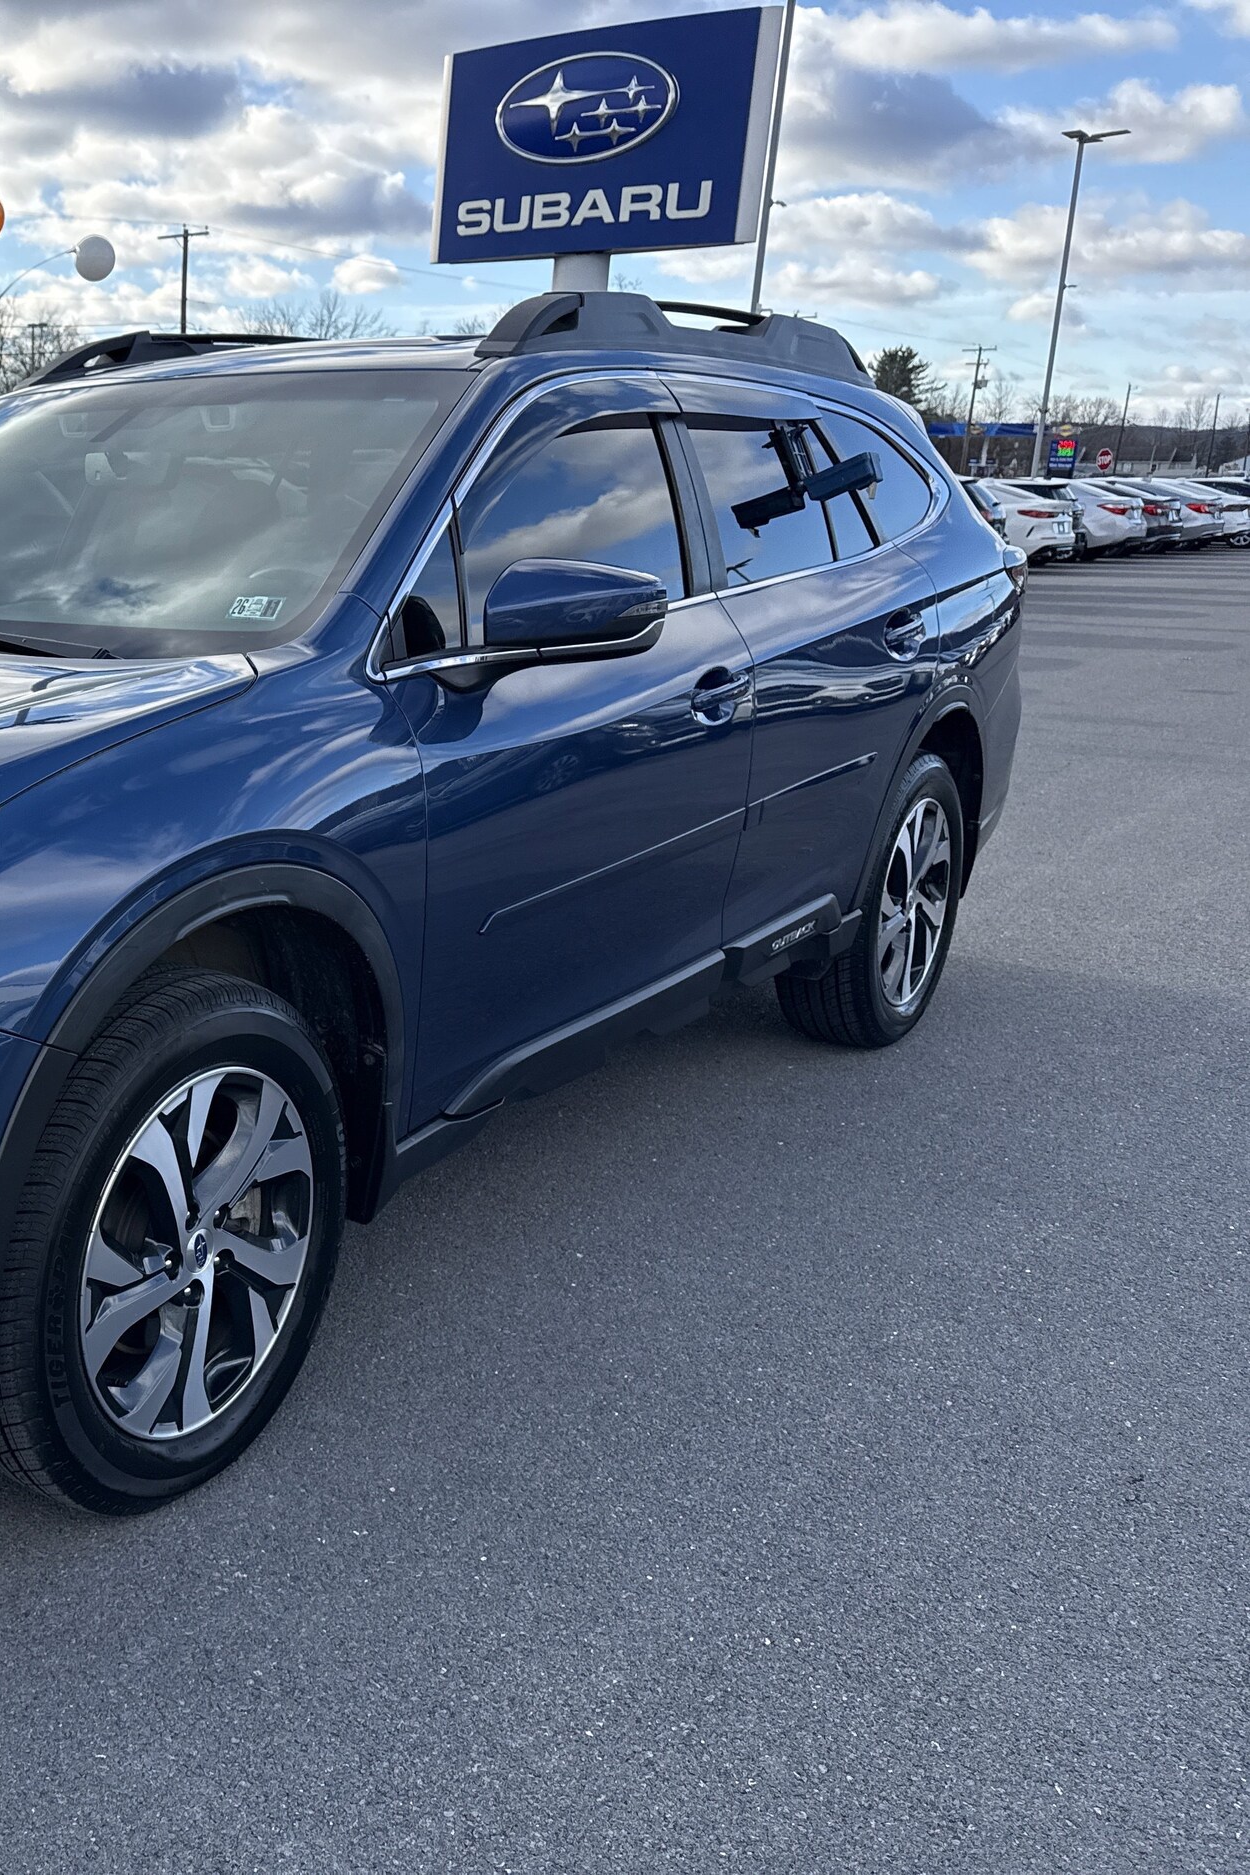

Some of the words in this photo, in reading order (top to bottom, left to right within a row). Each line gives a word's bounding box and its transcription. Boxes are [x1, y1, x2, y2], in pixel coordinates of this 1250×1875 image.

[456, 180, 713, 237] SUBARU
[1097, 454, 1112, 466] STOP
[231, 598, 250, 615] 26
[771, 920, 816, 951] OUTBACK
[47, 1313, 72, 1409] TIGER
